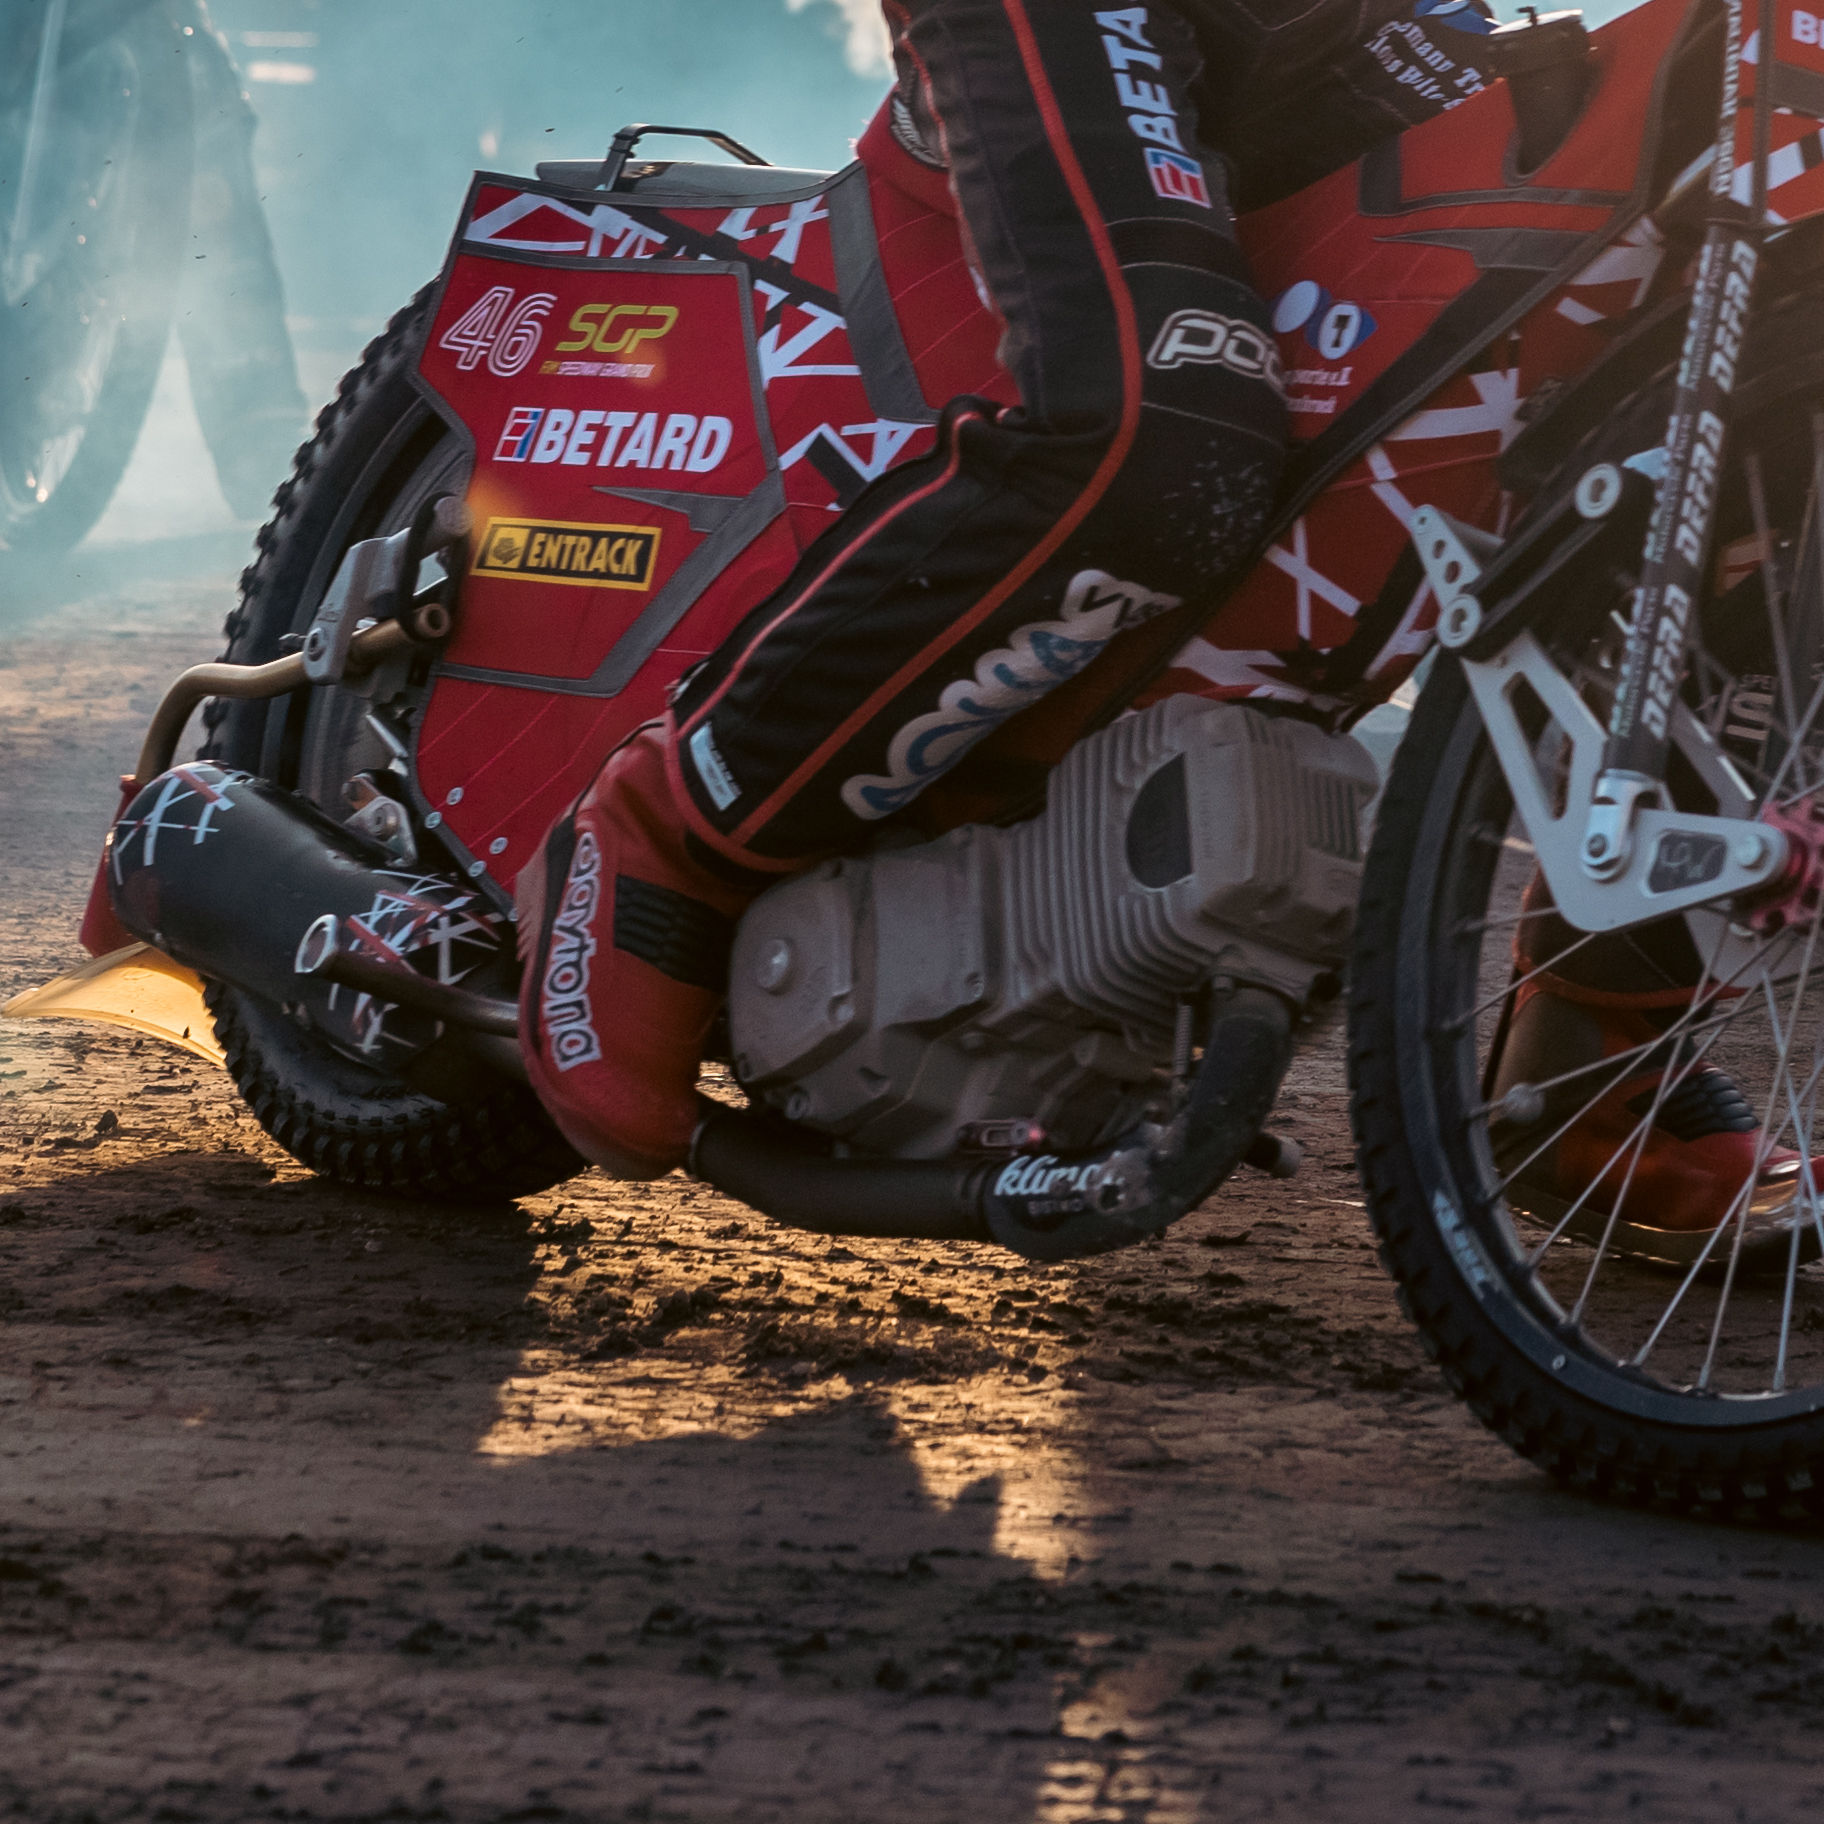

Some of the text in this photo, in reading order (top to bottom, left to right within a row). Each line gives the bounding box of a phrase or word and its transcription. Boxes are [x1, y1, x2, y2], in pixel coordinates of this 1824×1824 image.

[439, 285, 679, 378] 46 SGP
[530, 409, 733, 474] BETARD
[526, 531, 640, 577] ENTRACK
